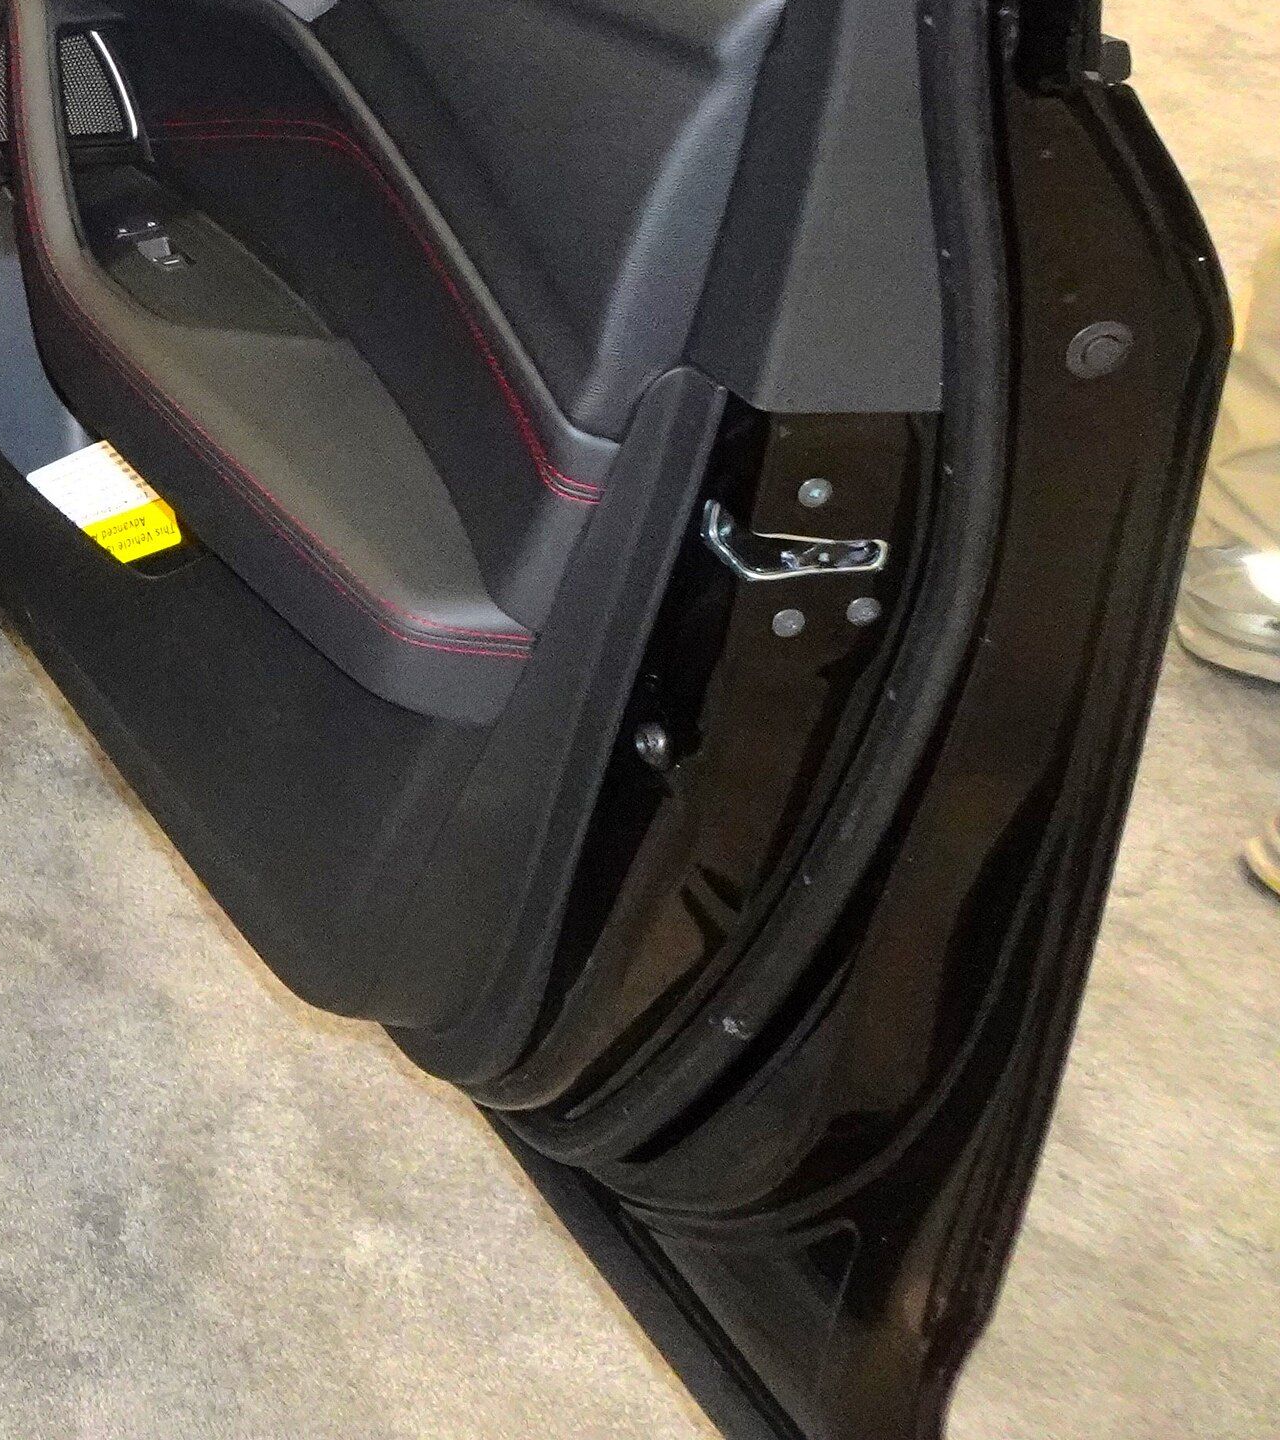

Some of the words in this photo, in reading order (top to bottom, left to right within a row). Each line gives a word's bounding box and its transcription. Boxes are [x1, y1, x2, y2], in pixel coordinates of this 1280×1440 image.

[101, 517, 146, 540] Advanced
[155, 523, 176, 537] This
[118, 531, 154, 550] Vehicle
